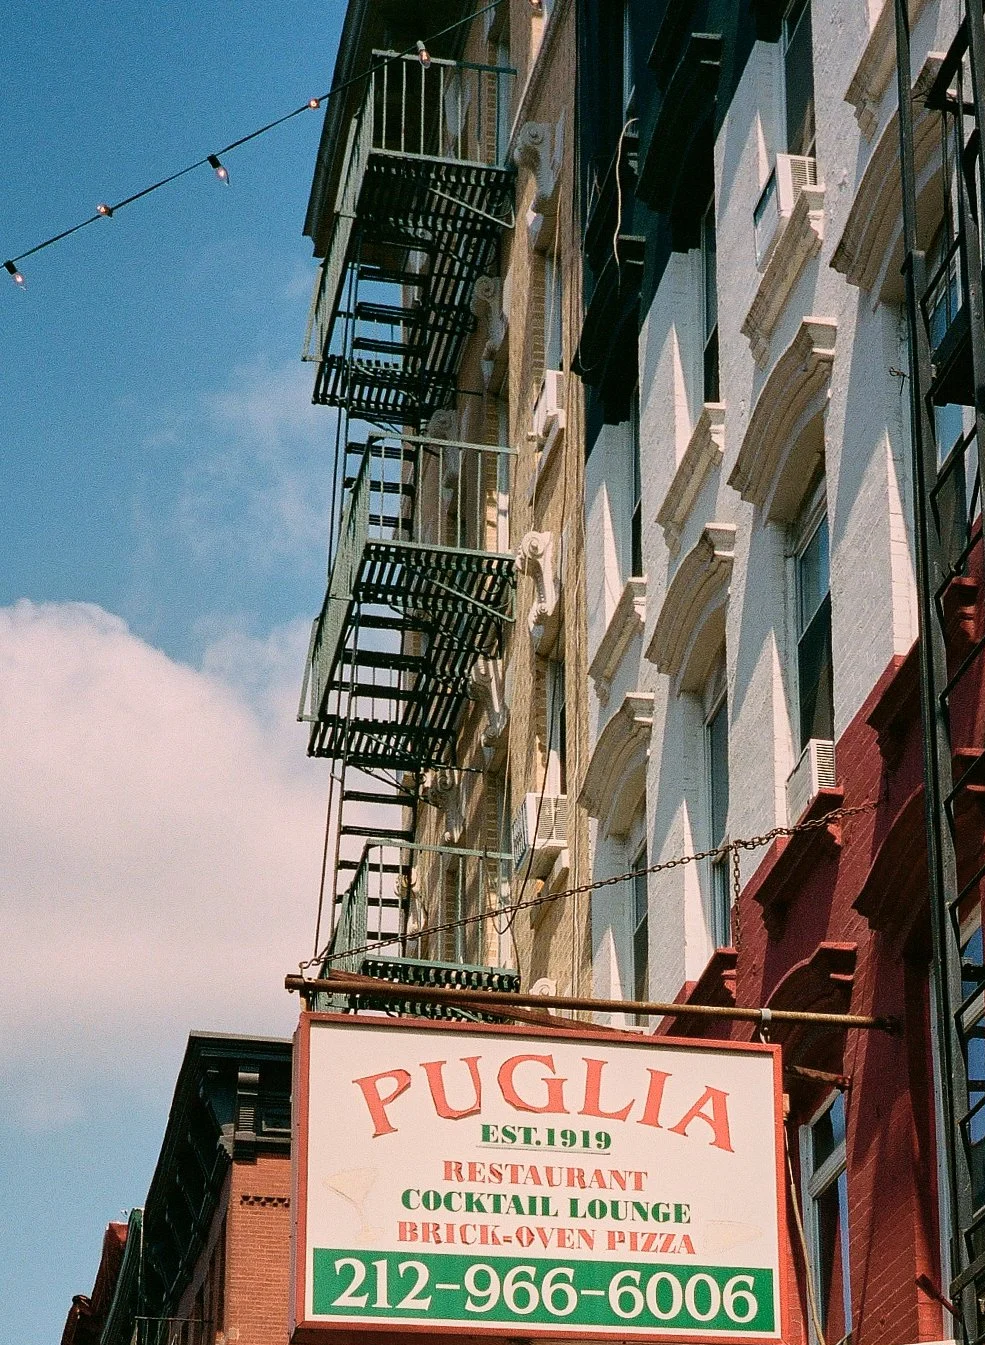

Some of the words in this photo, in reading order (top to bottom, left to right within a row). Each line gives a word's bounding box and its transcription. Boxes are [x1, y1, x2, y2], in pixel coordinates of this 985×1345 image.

[352, 1053, 735, 1153] PUGLIA
[442, 1160, 648, 1192] RESTAURANT
[401, 1188, 559, 1218] COCKTAIL
[569, 1197, 691, 1225] LOUNGE
[396, 1220, 596, 1252] BRICK-OVEN
[606, 1230, 697, 1256] PIZZA
[331, 1256, 759, 1324] 212-966-6006
